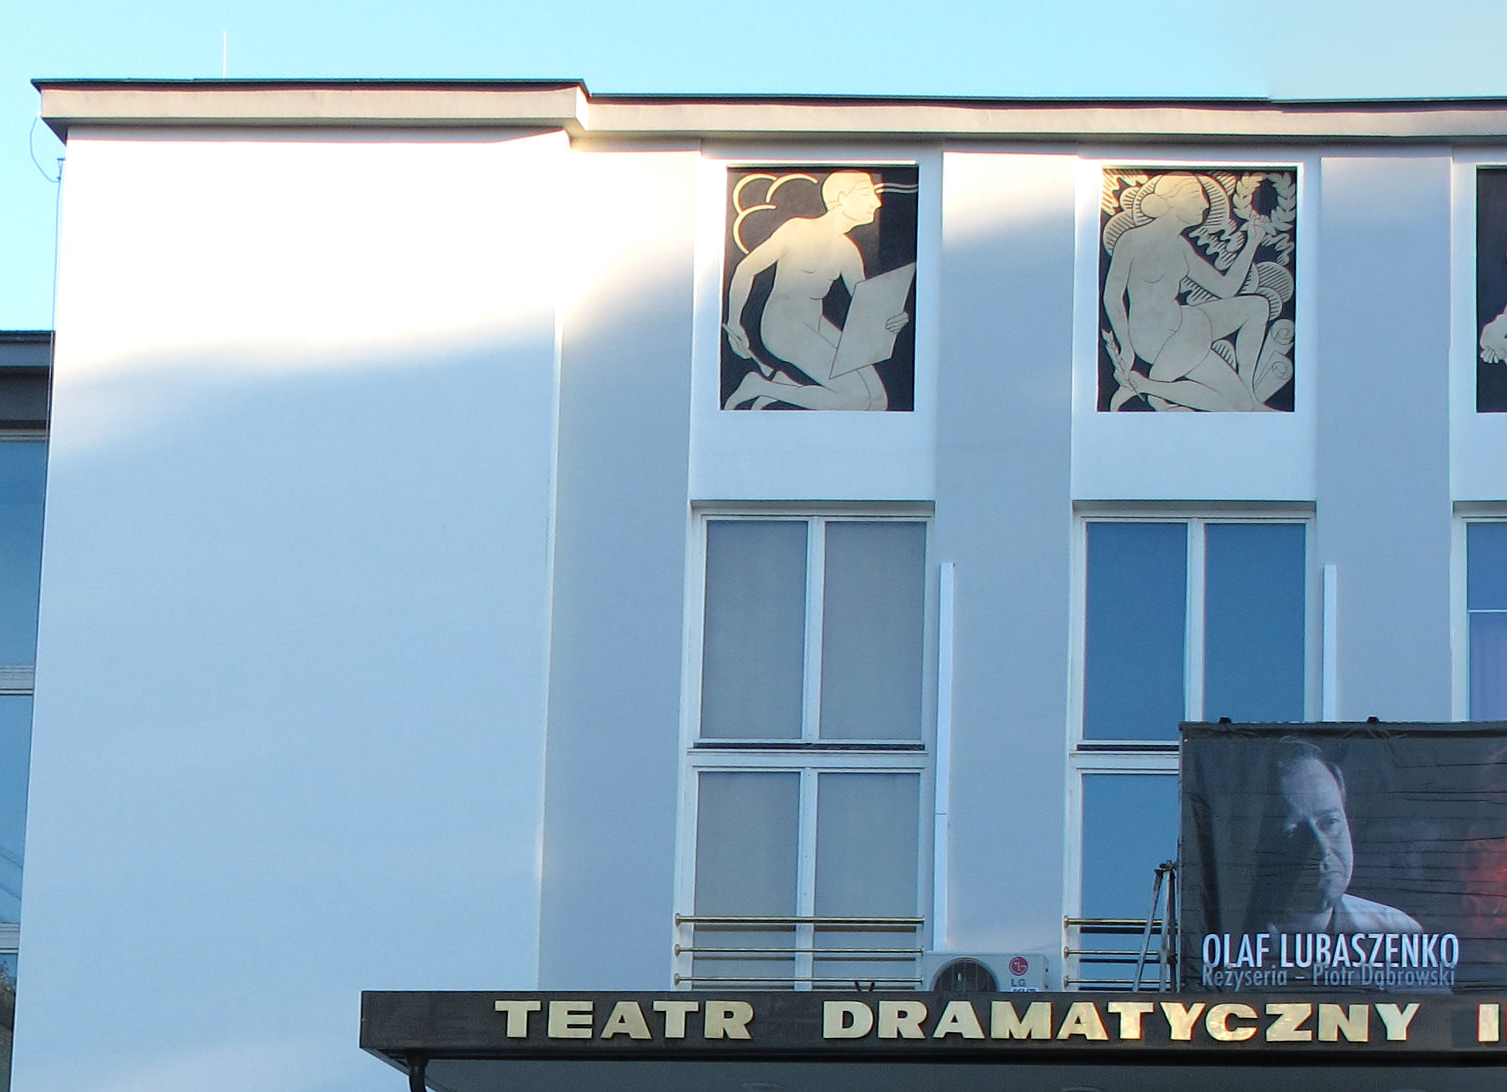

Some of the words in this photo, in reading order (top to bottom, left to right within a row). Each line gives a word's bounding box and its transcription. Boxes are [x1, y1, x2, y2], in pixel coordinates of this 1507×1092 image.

[1202, 933, 1270, 968] OLAF
[1280, 933, 1460, 968] LUBASZENKO
[1011, 978, 1026, 987] LG
[1202, 964, 1287, 991] Reżyseria
[1312, 964, 1356, 986] Piotr
[1360, 964, 1455, 990] Dąbrowski
[494, 1000, 754, 1040] TEATR
[823, 1000, 1420, 1042] DRAMATYCZNY
